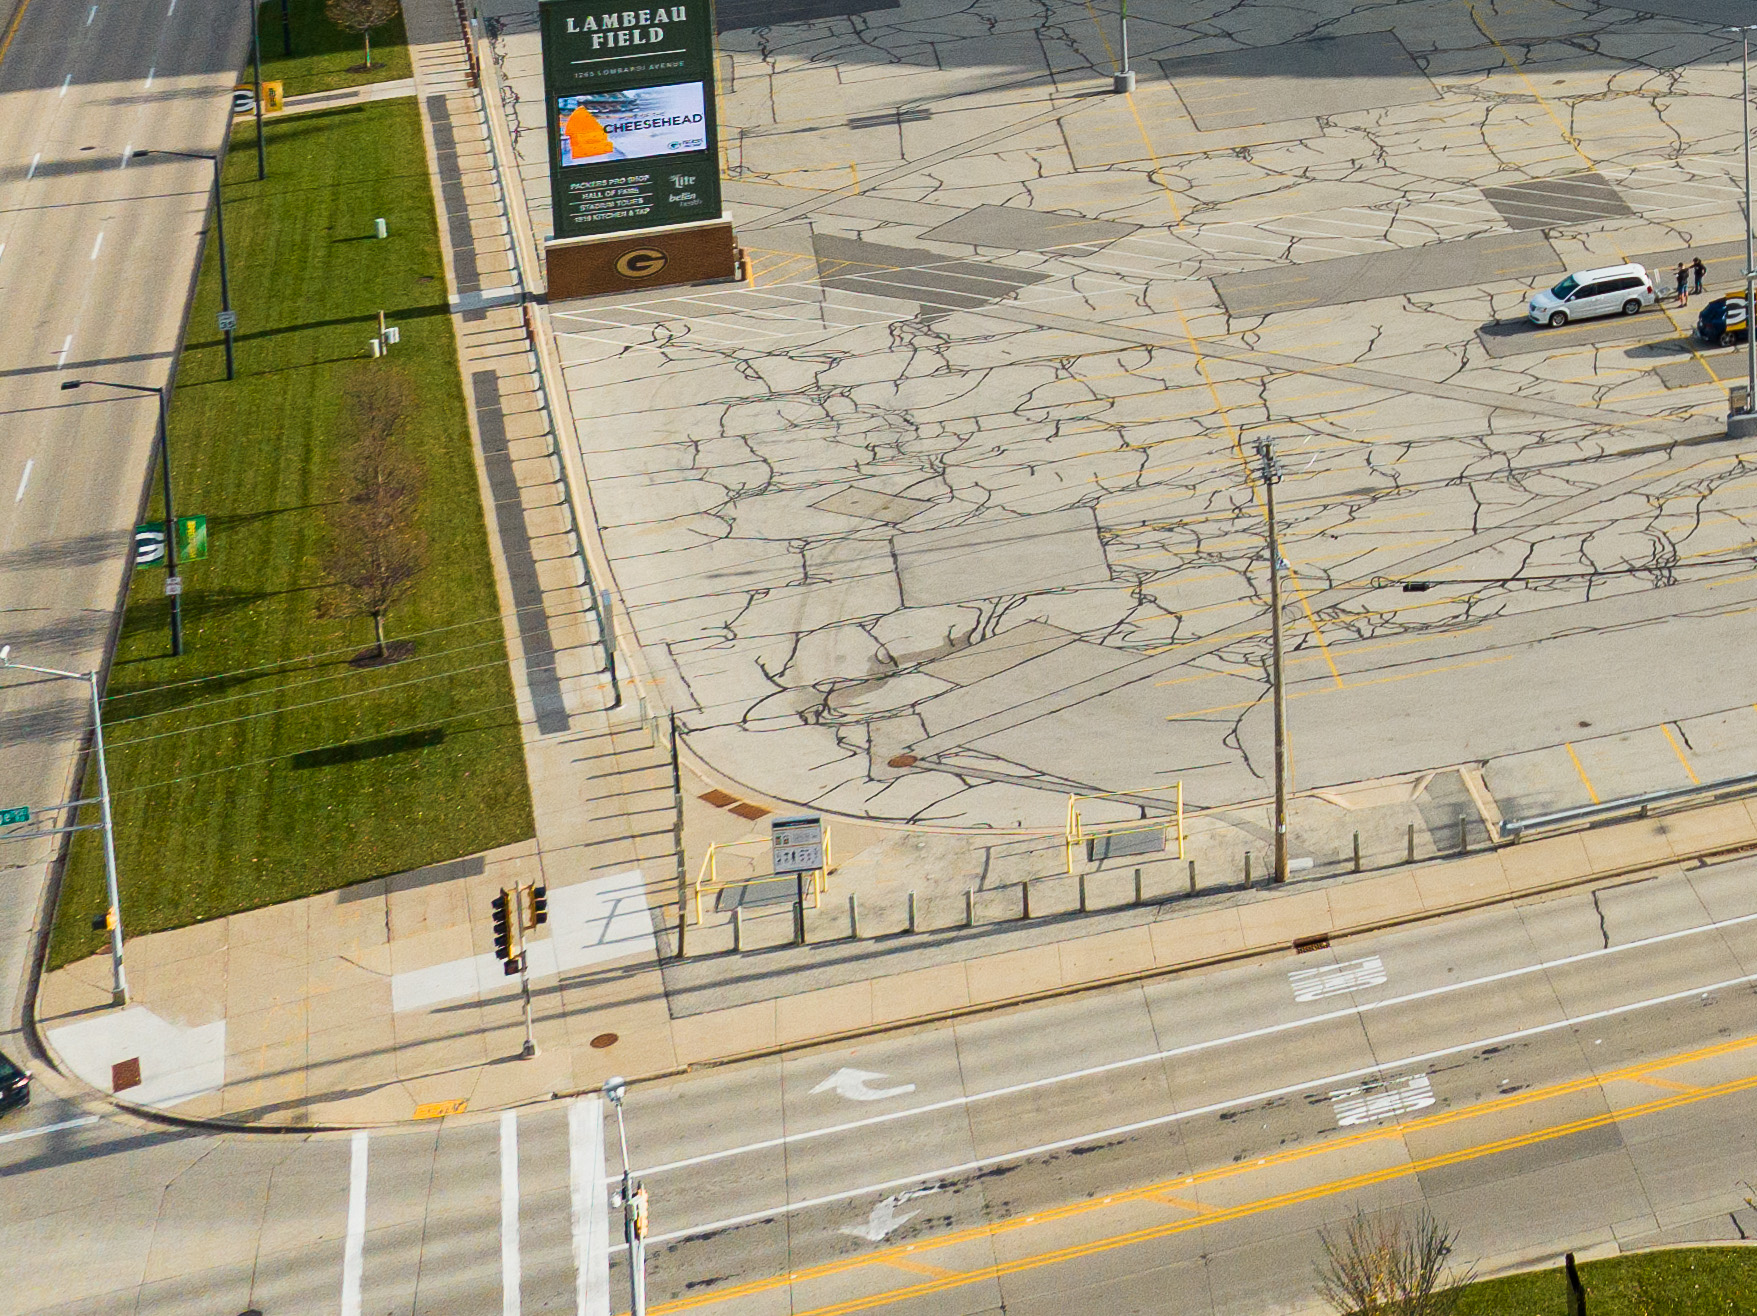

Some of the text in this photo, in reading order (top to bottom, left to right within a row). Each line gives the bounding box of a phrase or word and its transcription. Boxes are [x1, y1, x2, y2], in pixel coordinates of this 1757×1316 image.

[566, 6, 687, 33] LAMBEAU
[591, 27, 664, 49] FIELD
[649, 60, 685, 70] AVENUE
[603, 113, 703, 134] CHEESEHEAD
[668, 173, 697, 188] Lite
